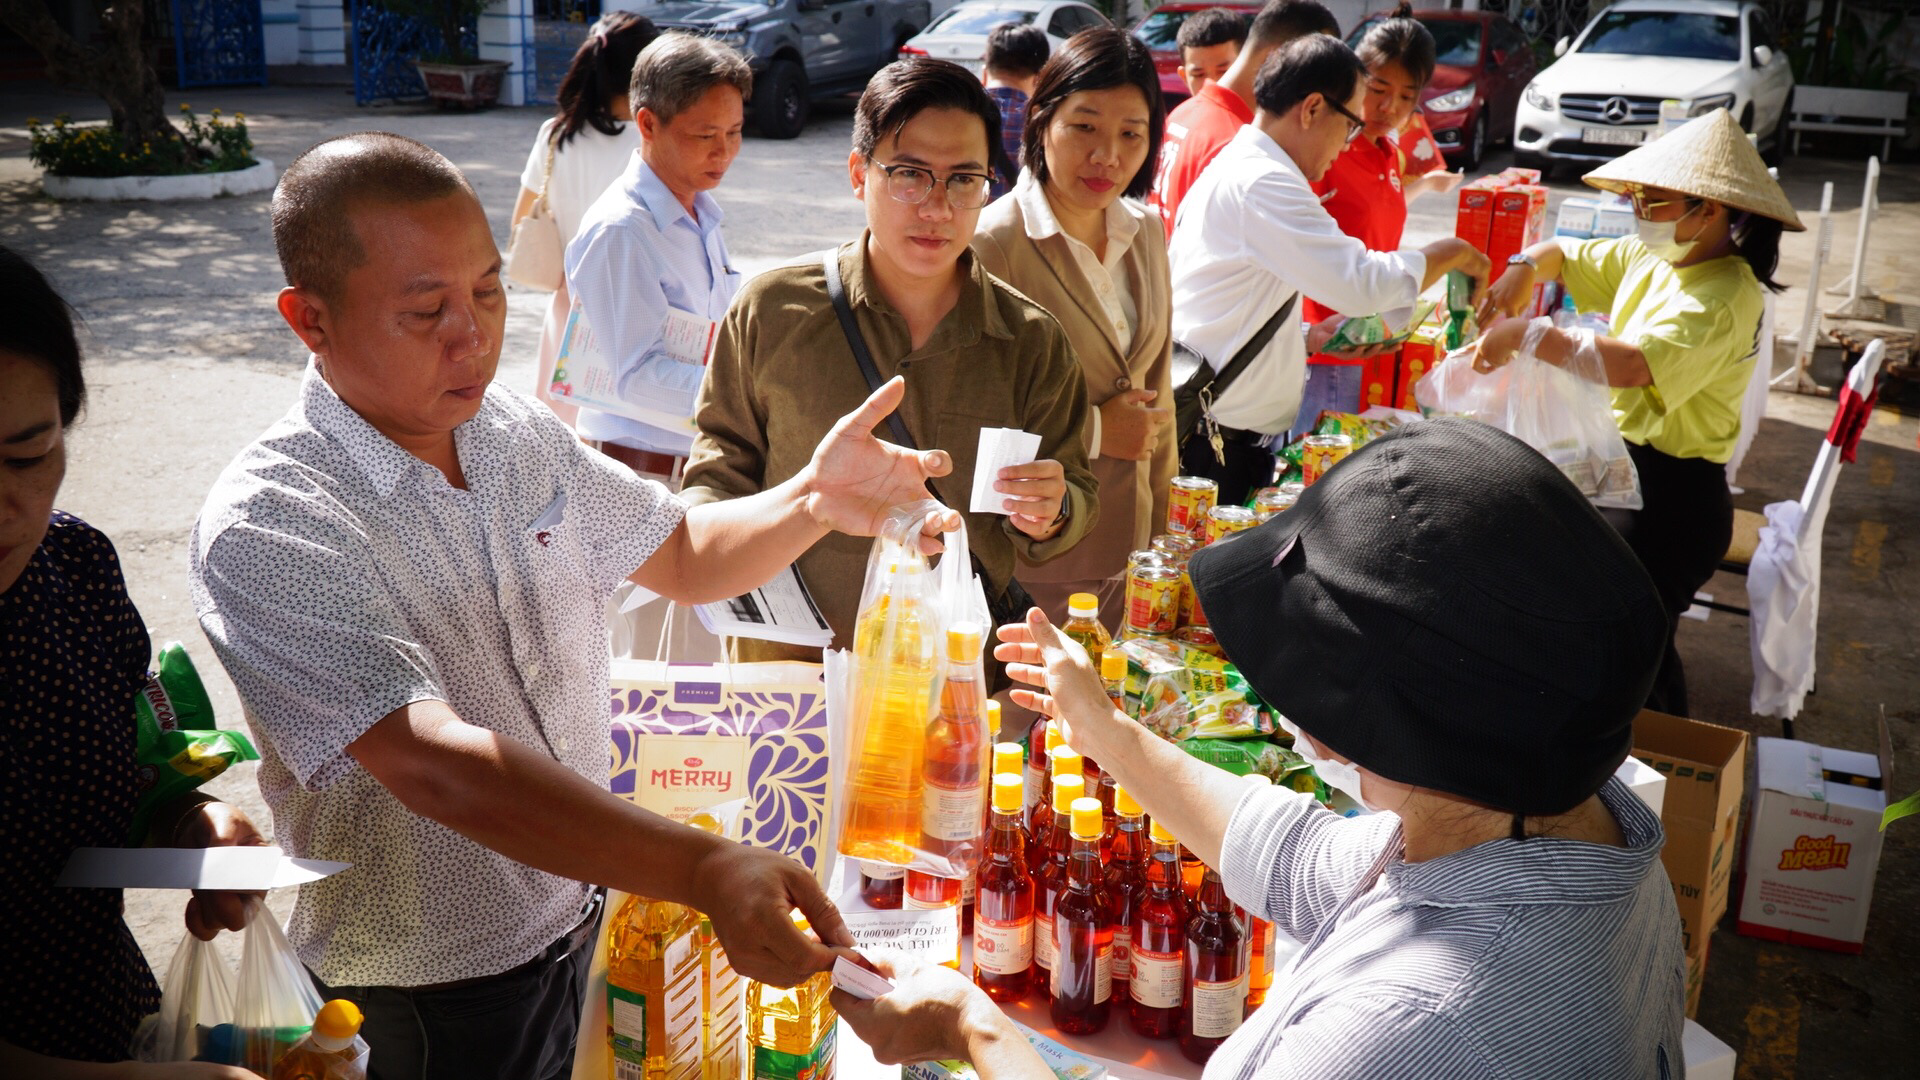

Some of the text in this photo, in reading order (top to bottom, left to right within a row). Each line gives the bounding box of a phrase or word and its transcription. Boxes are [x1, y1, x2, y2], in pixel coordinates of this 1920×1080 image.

[651, 768, 732, 793] MERRY
[1796, 835, 1834, 850] Good
[1779, 844, 1850, 870] Meall
[1037, 1042, 1064, 1060] Mask
